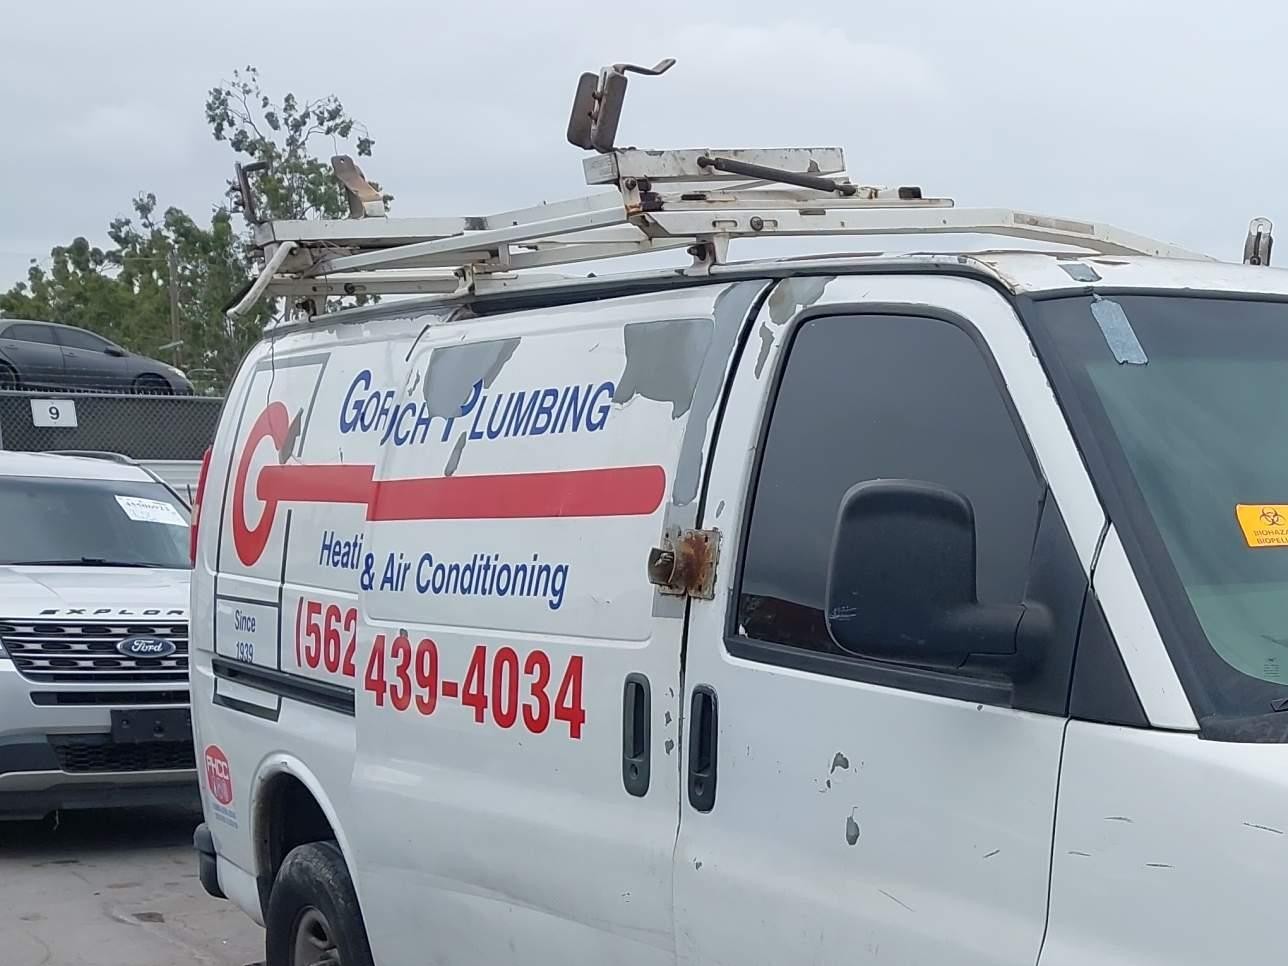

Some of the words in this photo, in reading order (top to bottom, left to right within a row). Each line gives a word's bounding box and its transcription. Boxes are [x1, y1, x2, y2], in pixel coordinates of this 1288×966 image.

[48, 406, 60, 420] 9
[360, 552, 376, 591] &
[380, 552, 411, 592] Air
[416, 552, 569, 610] Conditioning
[234, 609, 256, 632] Since
[131, 639, 163, 652] Ford
[236, 641, 254, 663] 1939
[365, 634, 586, 739] 439-4034
